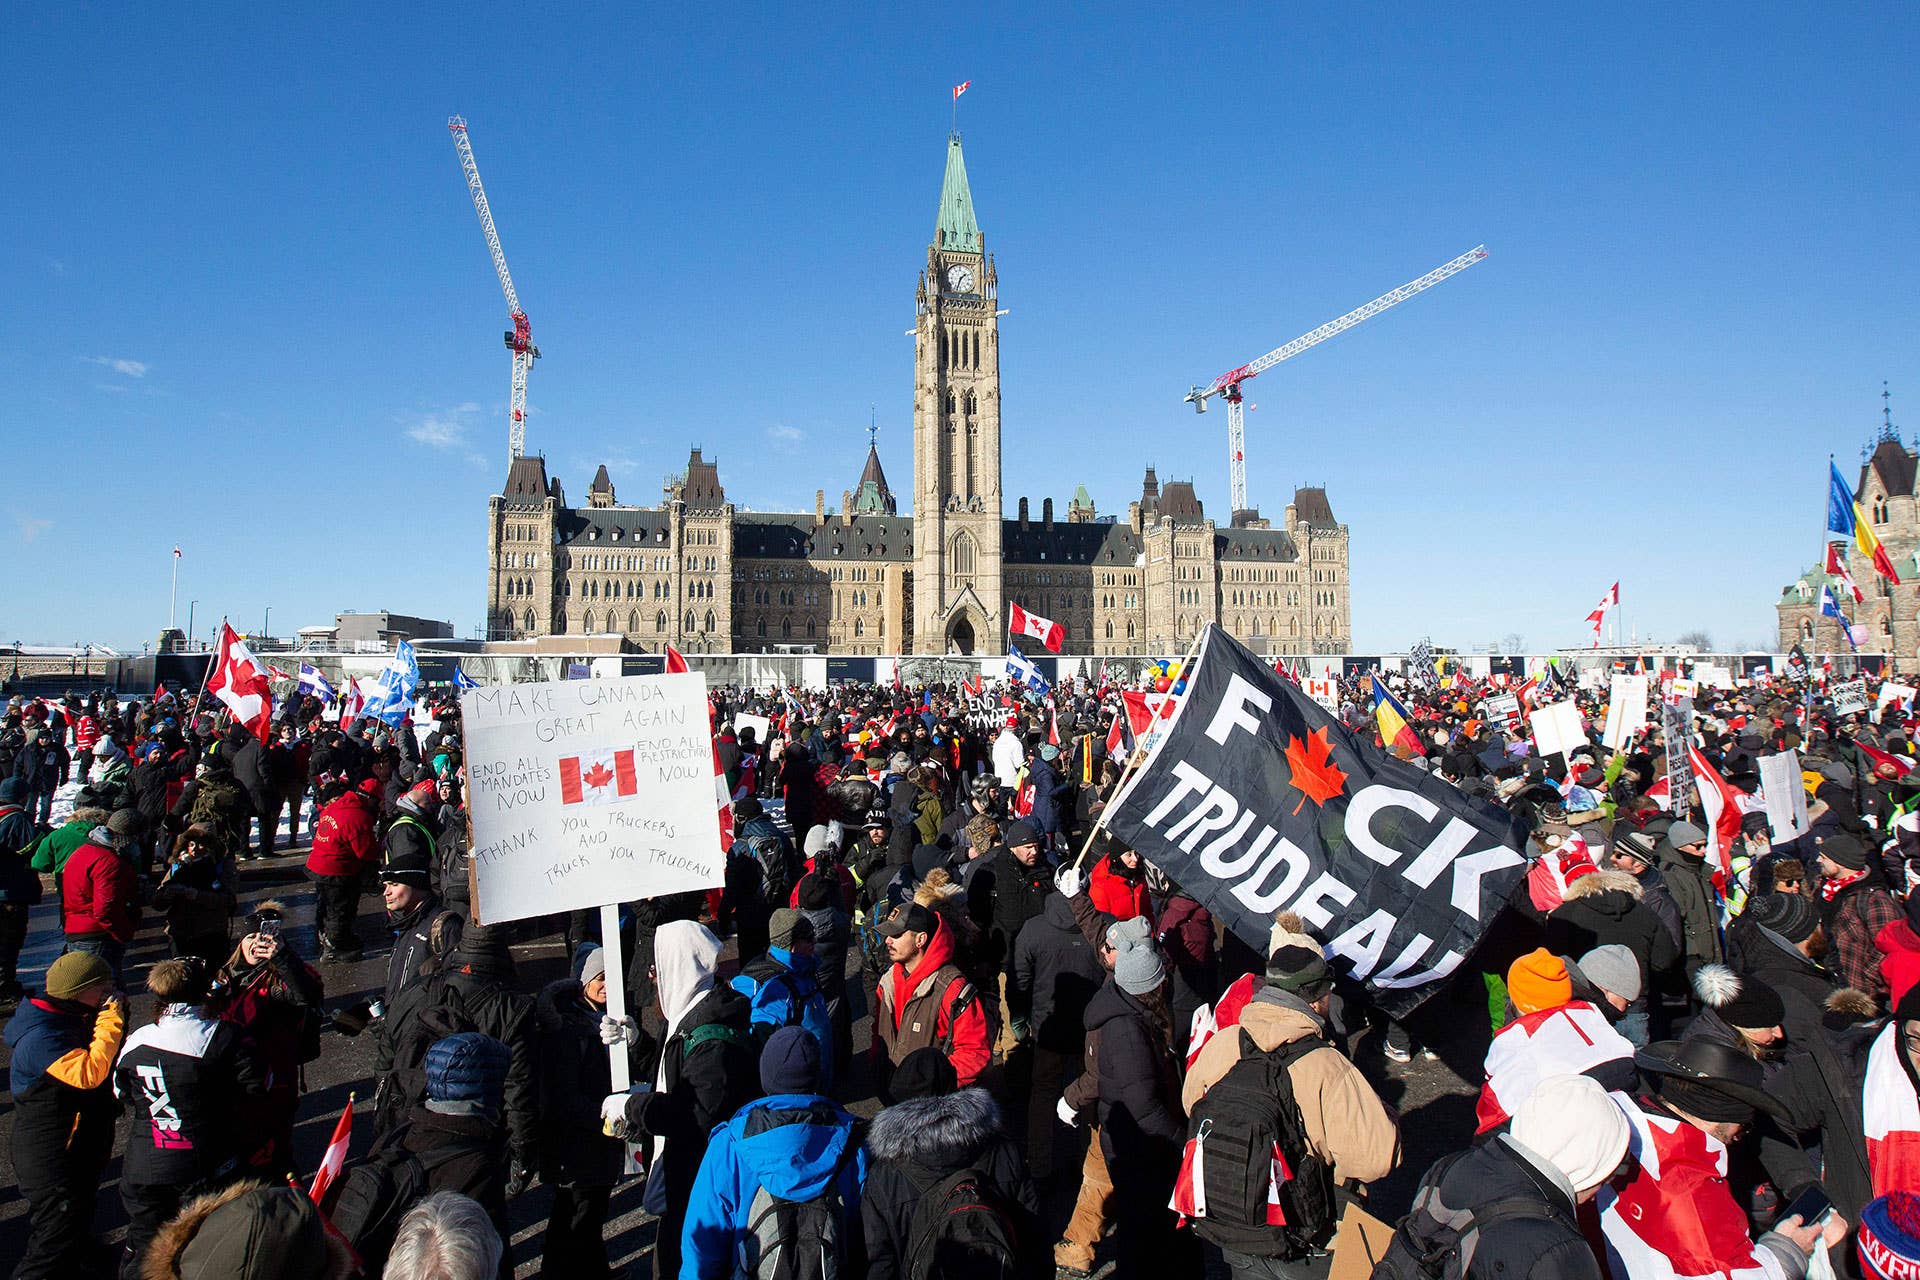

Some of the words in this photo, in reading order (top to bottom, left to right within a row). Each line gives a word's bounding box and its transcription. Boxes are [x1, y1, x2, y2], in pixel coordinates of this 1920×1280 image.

[475, 688, 555, 718] MAKE
[578, 684, 665, 706] CANADA
[968, 696, 996, 712] END
[536, 712, 600, 742] GREAT
[623, 705, 686, 728] AGAIN
[637, 739, 667, 750] END
[679, 736, 703, 748] ALL
[473, 761, 506, 779] END
[517, 757, 544, 770] ALL
[481, 768, 551, 792] MANDATES
[658, 767, 699, 783] NOW
[498, 786, 546, 811] NOW
[477, 827, 538, 866] THANK
[560, 817, 590, 834] YOU
[607, 812, 676, 839] TRUCKERS
[578, 831, 608, 847] AND
[1344, 784, 1526, 921] CK
[543, 855, 590, 886] TRUCK
[609, 846, 634, 860] YOU
[648, 848, 712, 880] TRUDEAU
[1143, 760, 1464, 988] TRUDEAU
